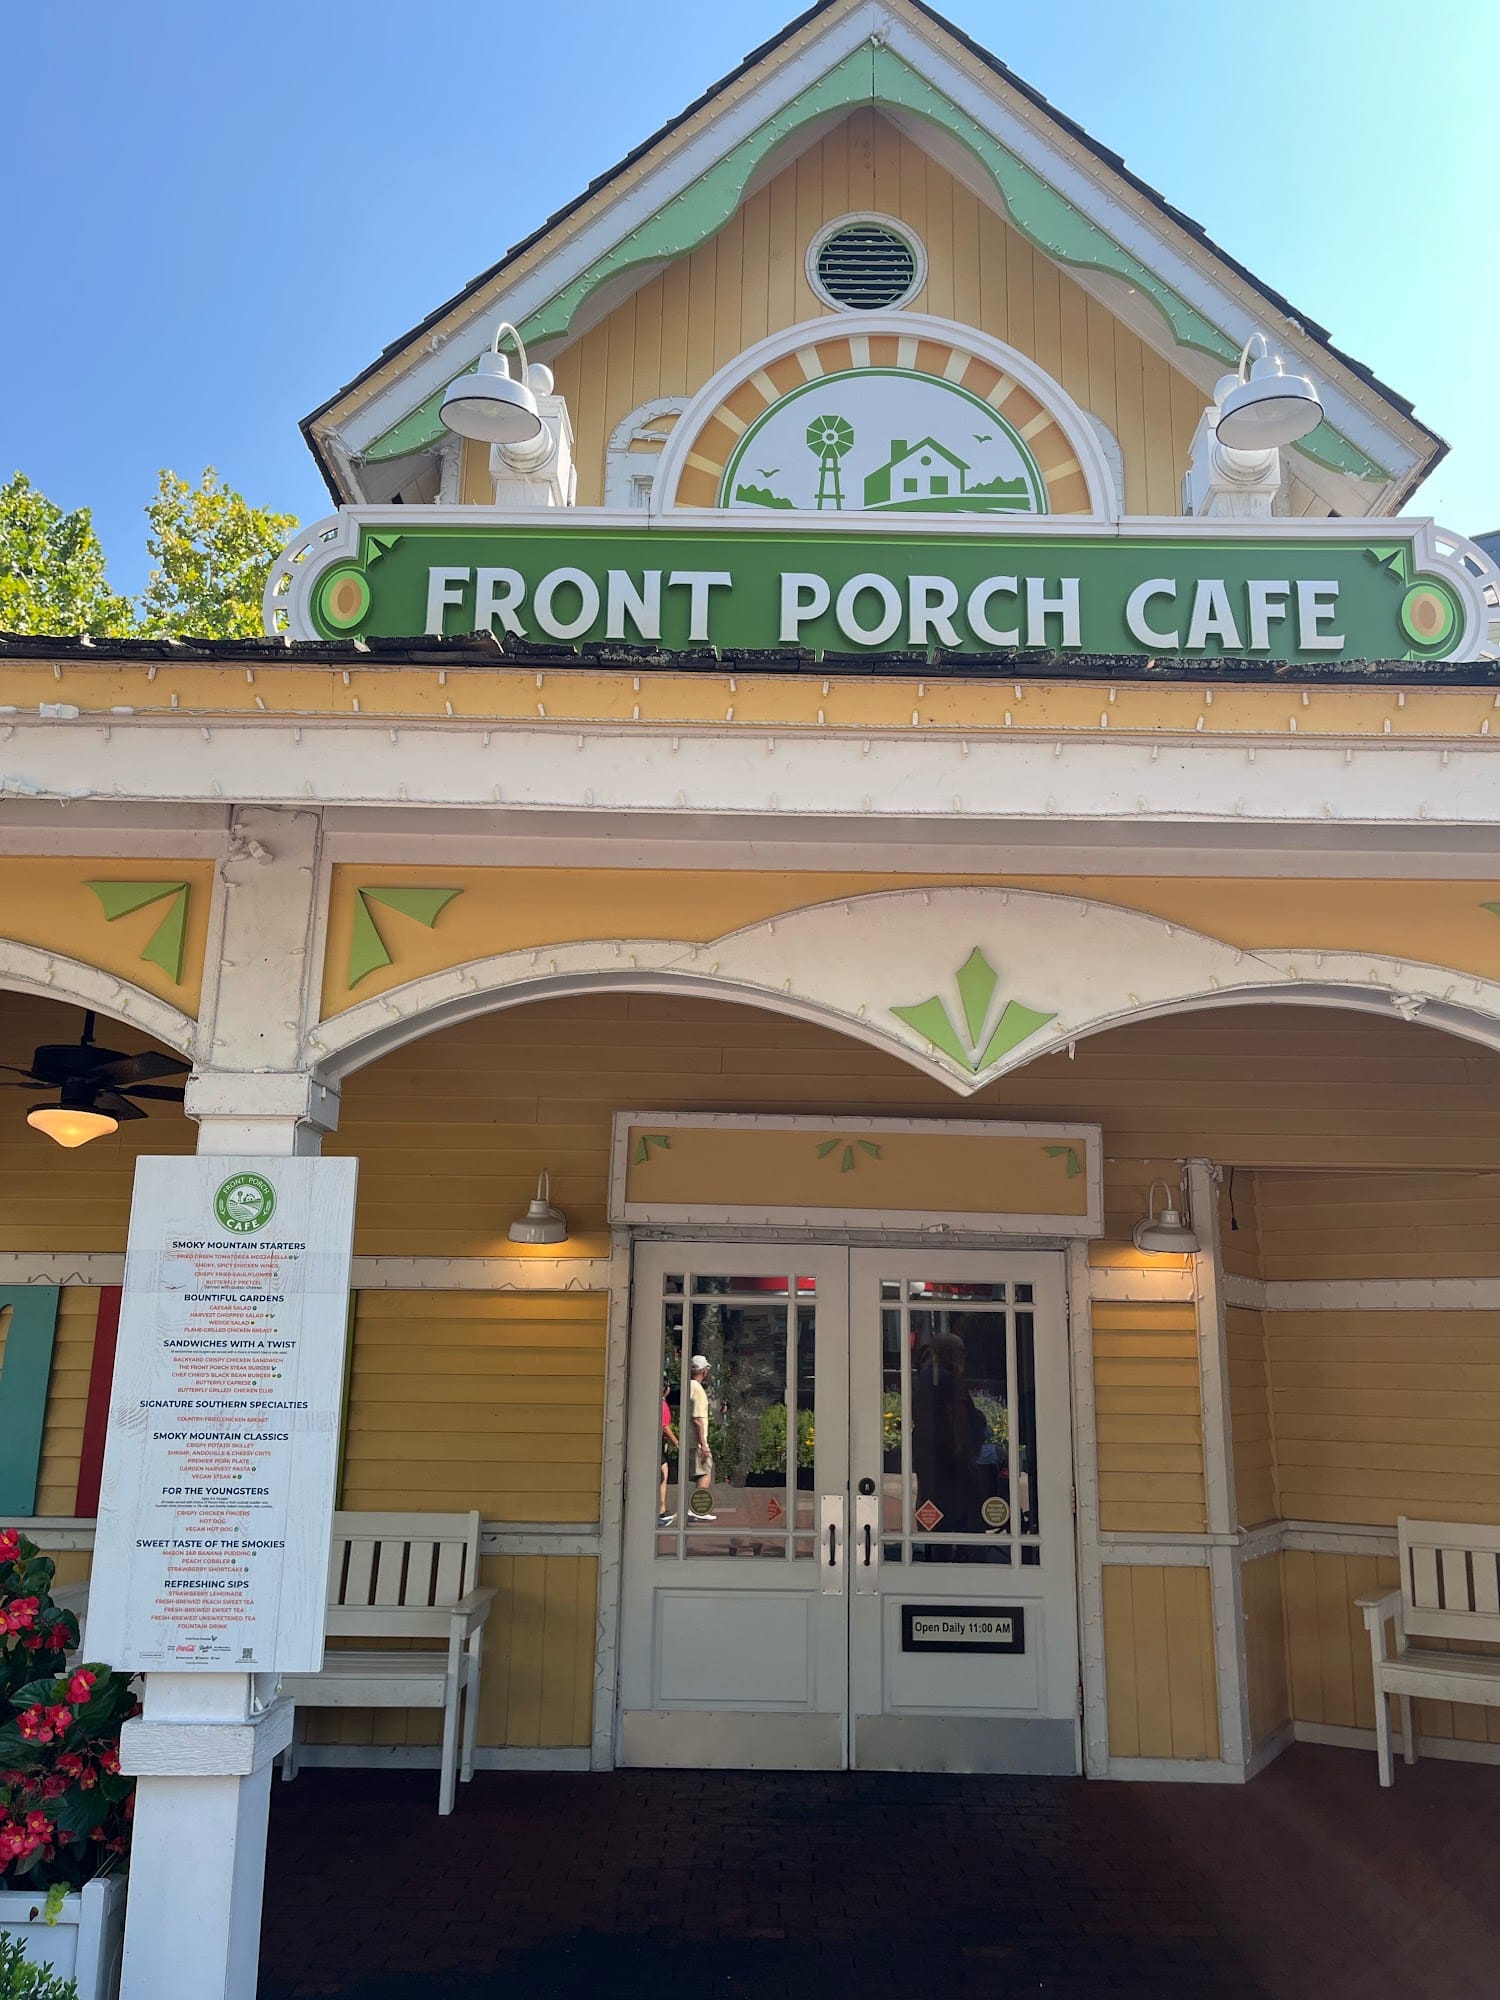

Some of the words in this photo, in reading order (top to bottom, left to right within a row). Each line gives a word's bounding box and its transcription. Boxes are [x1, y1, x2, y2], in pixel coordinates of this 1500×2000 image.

[424, 565, 733, 642] FRONT
[779, 571, 1082, 648] PORCH
[1126, 577, 1346, 651] CAFE
[223, 1177, 245, 1194] FRONT
[249, 1177, 269, 1194] PORCH
[226, 1219, 259, 1230] CAFE
[915, 1622, 939, 1633] Open
[942, 1622, 965, 1635] Daily
[969, 1624, 992, 1633] 11:00
[996, 1624, 1010, 1633] AM
